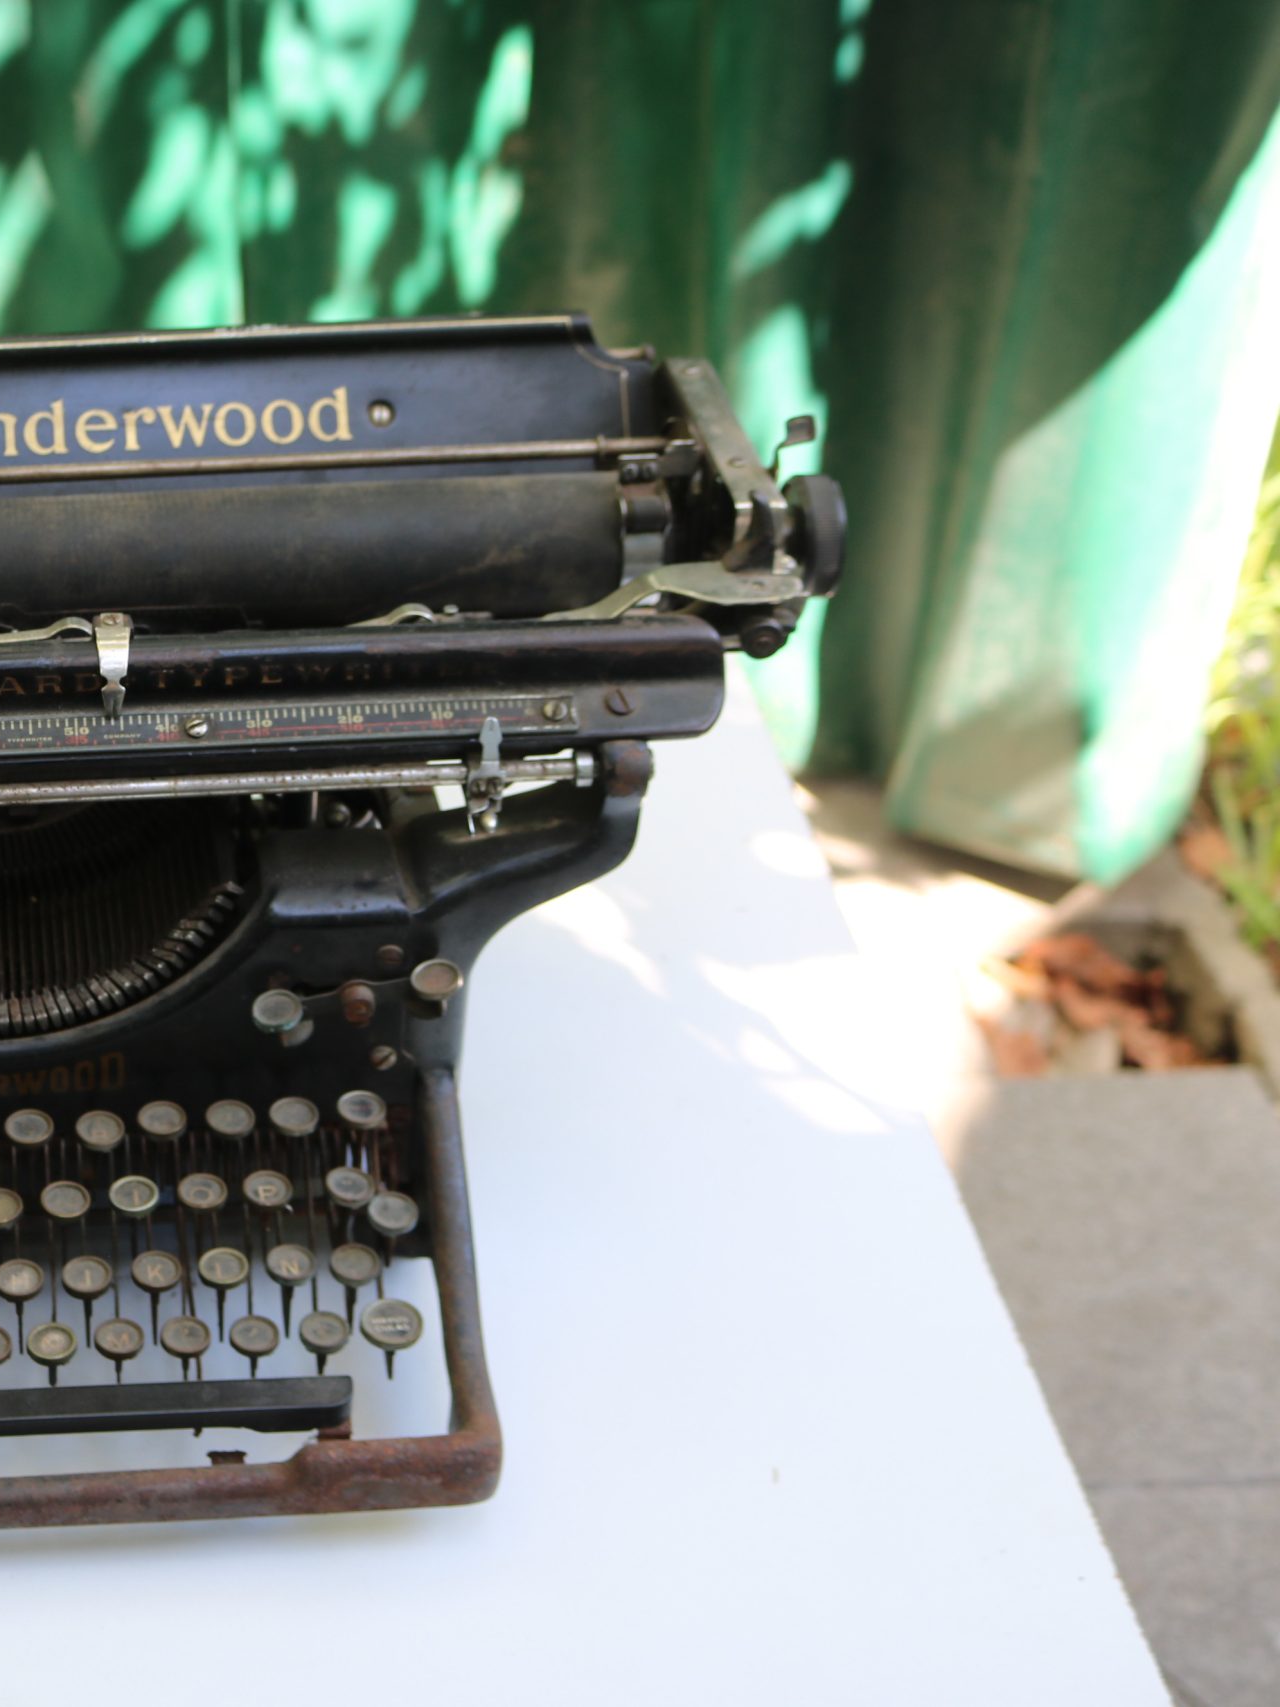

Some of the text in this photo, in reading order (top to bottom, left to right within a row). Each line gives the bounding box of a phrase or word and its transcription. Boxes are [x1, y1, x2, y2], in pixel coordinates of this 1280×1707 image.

[64, 726, 90, 736] 50
[246, 719, 273, 729] 30
[337, 715, 363, 724] 20
[431, 710, 454, 720] 10
[257, 1185, 276, 1201] P
[146, 1263, 166, 1282] K
